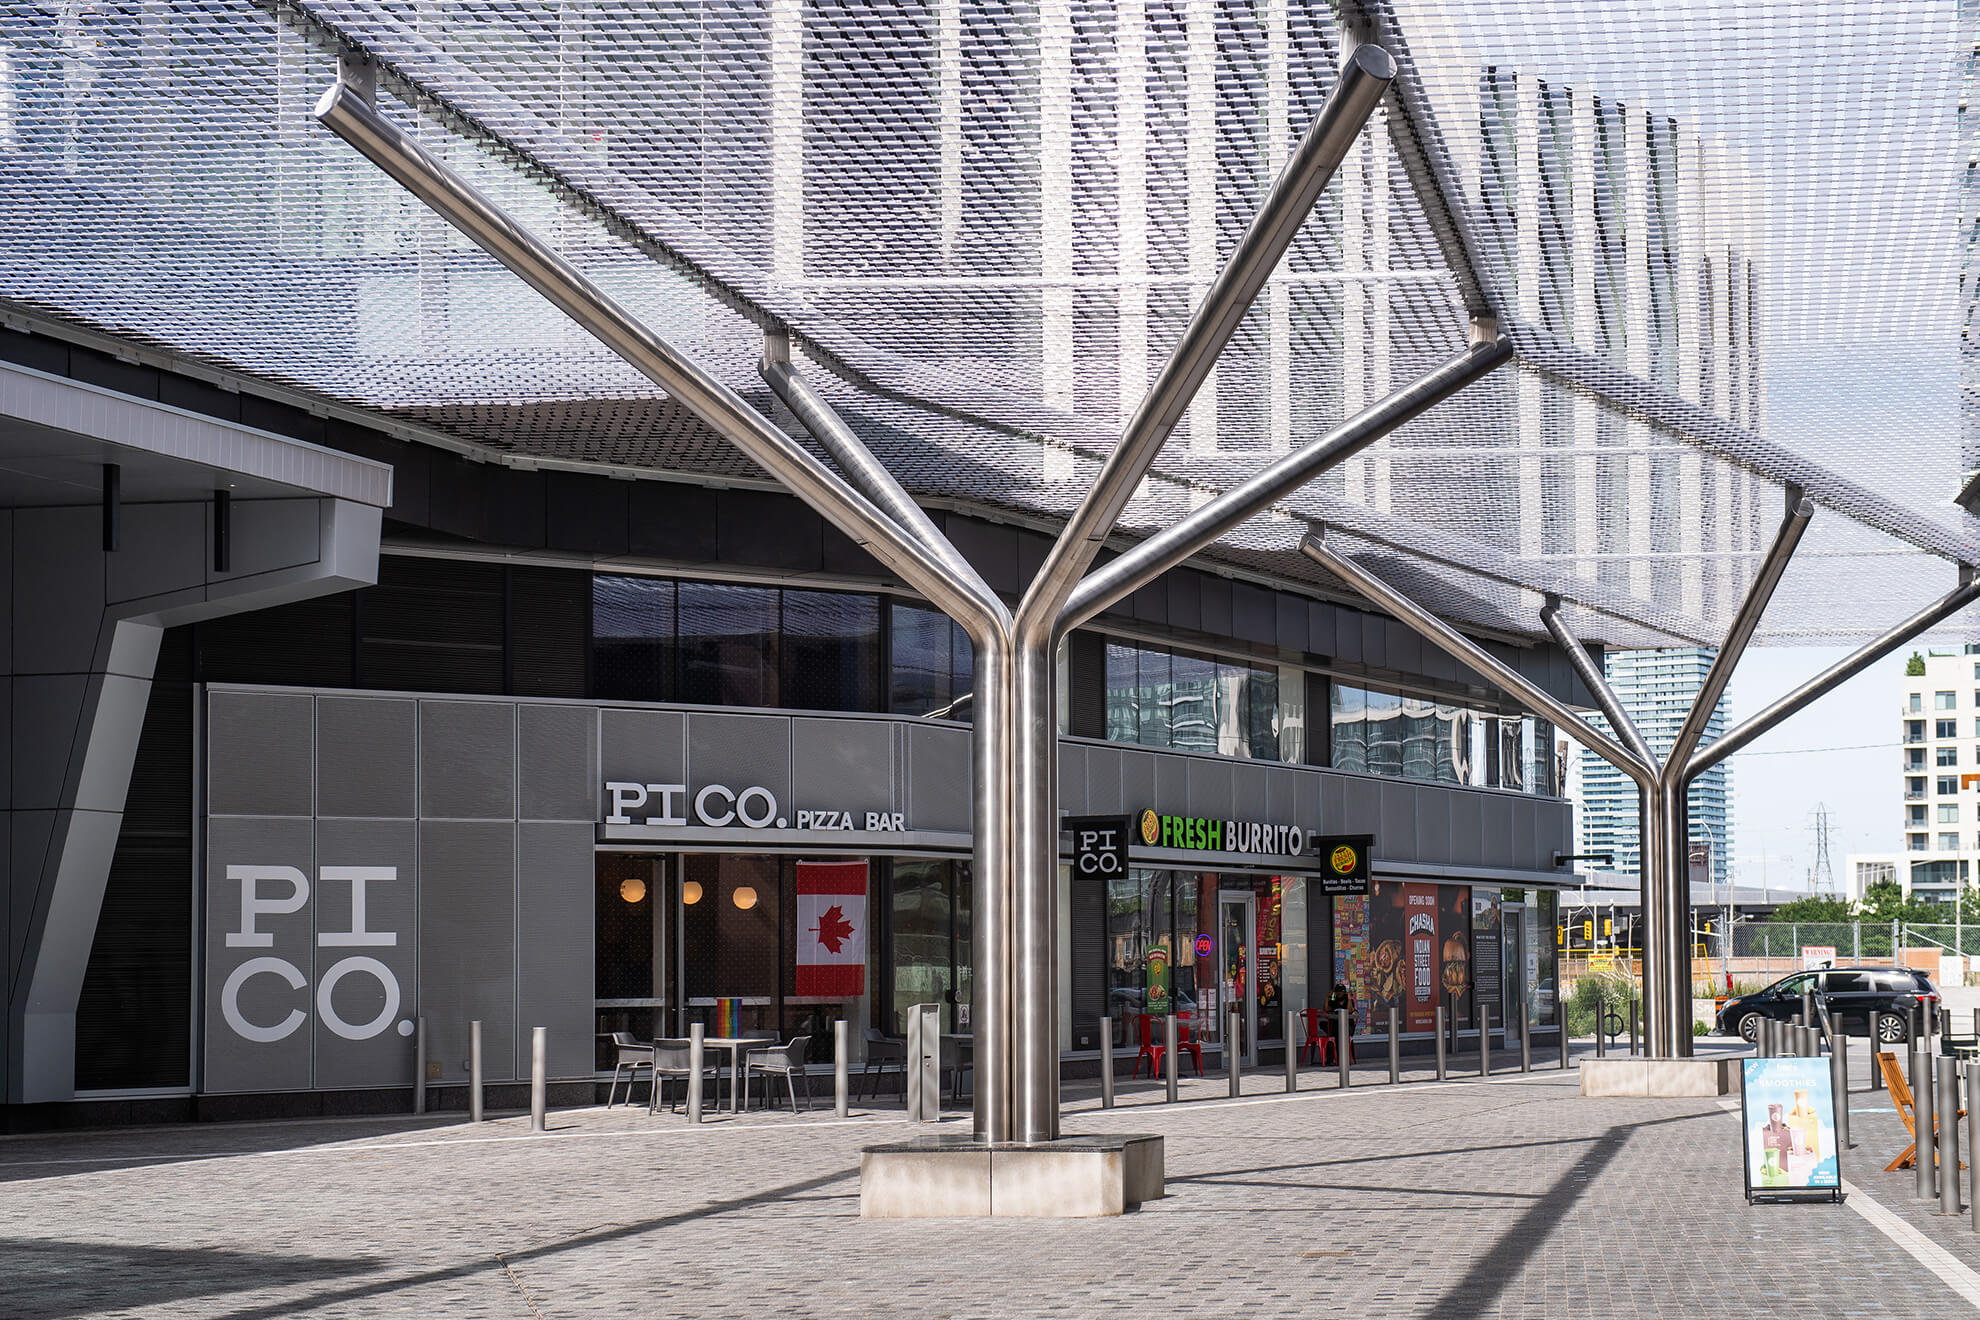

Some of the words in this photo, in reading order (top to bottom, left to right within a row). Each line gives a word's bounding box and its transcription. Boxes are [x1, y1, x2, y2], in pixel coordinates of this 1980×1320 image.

[797, 810, 854, 831] PIZZA
[865, 812, 906, 832] BAR
[1080, 830, 1117, 851] PI
[1162, 815, 1221, 851] FRESH
[1226, 821, 1303, 857] BURRITO
[1080, 852, 1123, 874] CO.
[225, 865, 397, 948] PI
[1408, 895, 1425, 905] OPENING
[1425, 895, 1435, 906] SOON
[1195, 939, 1212, 951] OPEN
[1414, 939, 1431, 954] INDIAN
[1414, 954, 1431, 967] STREET
[1414, 967, 1431, 986] FOOD
[221, 956, 415, 1043] CO.
[1759, 1079, 1817, 1088] SMOOTHIES
